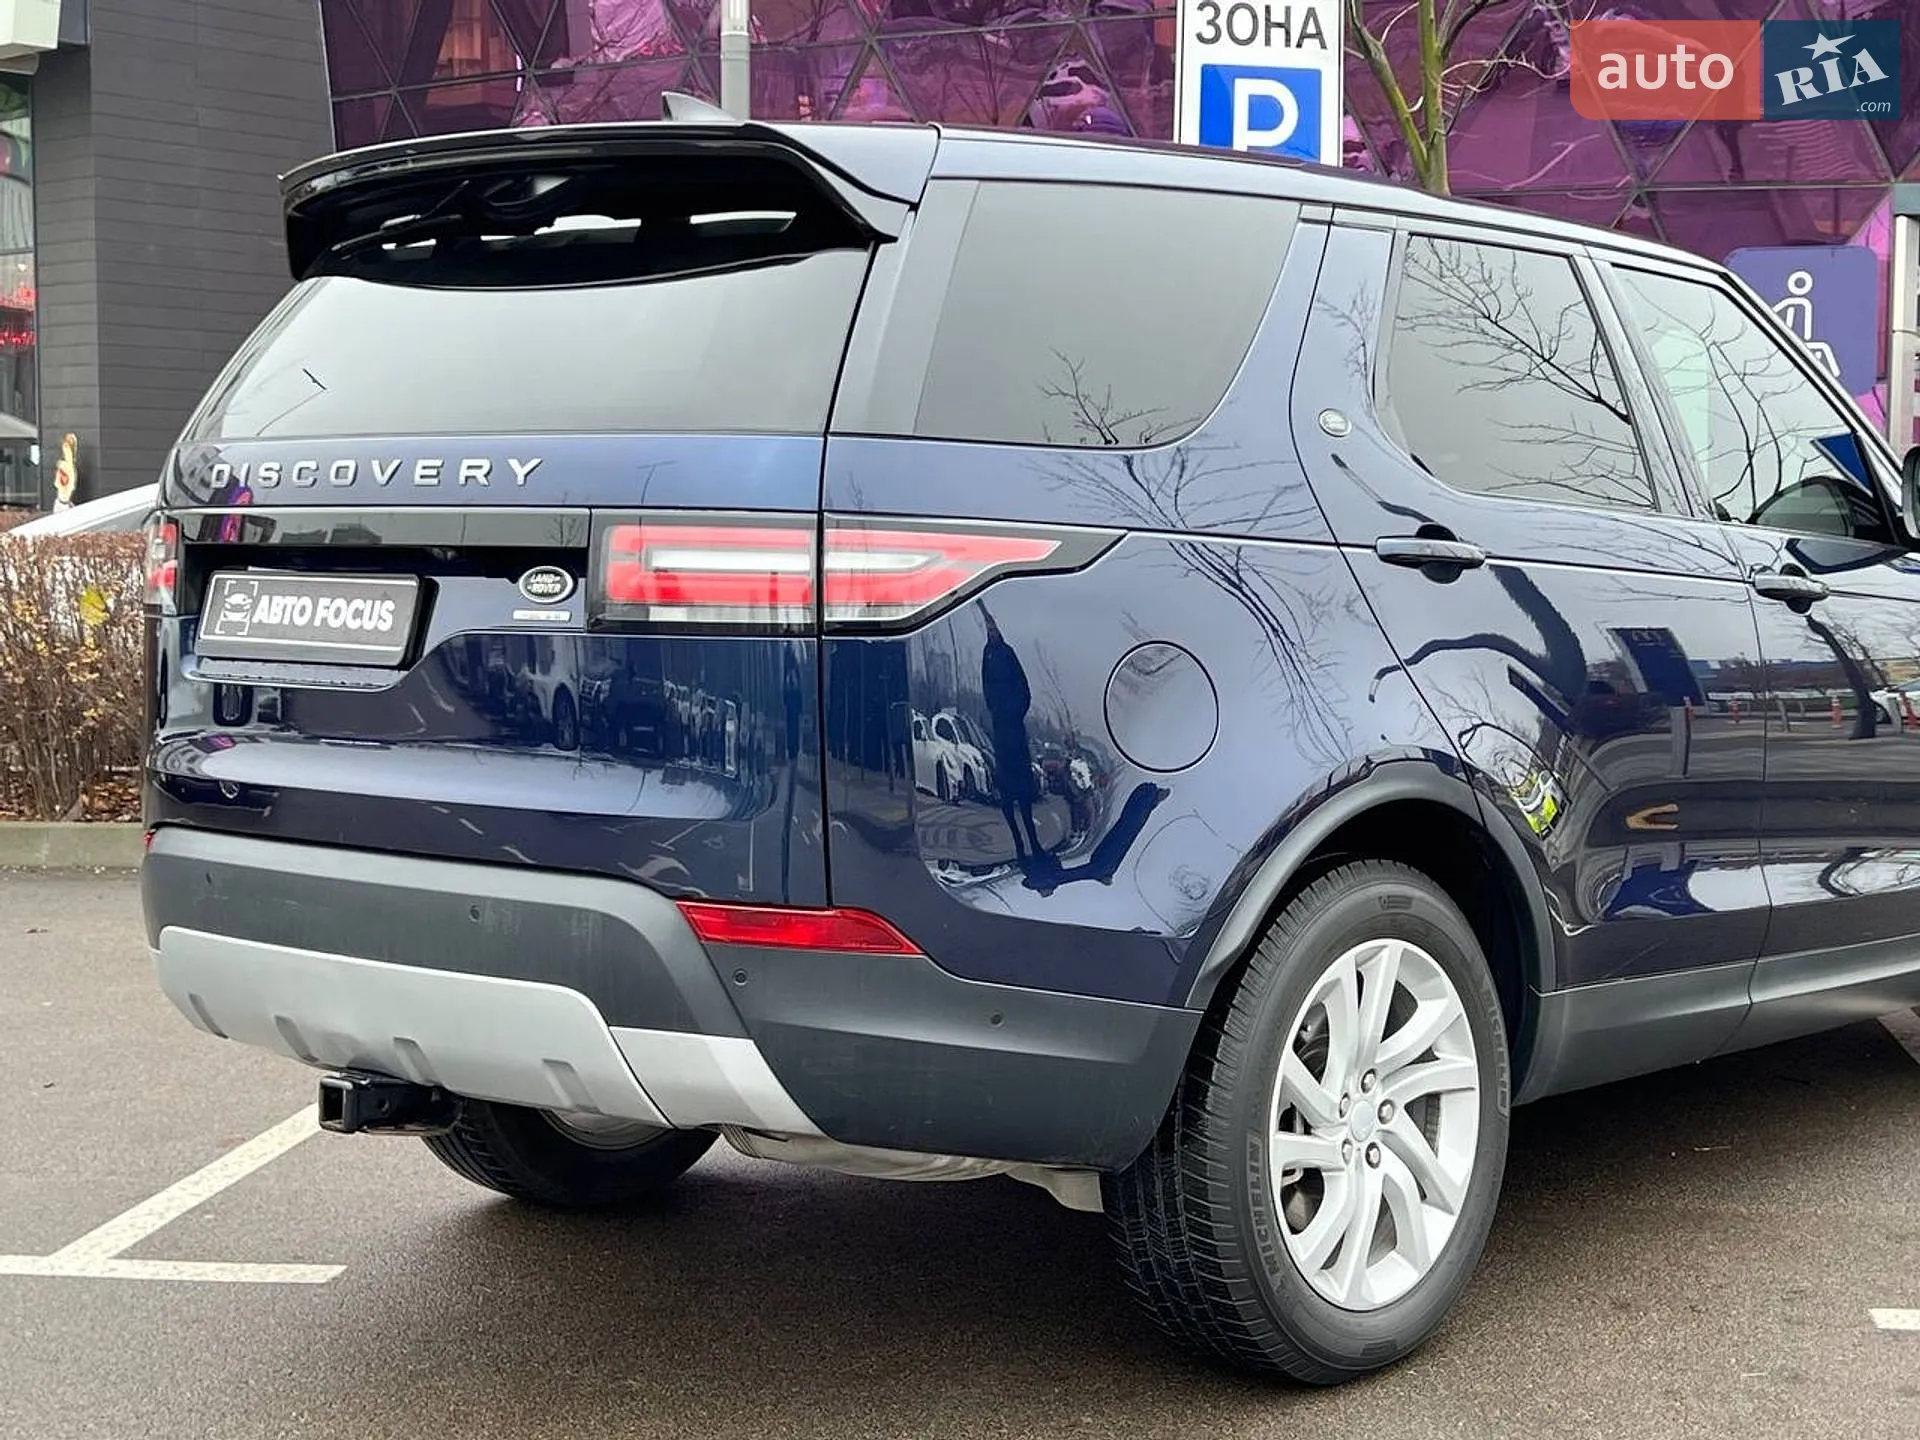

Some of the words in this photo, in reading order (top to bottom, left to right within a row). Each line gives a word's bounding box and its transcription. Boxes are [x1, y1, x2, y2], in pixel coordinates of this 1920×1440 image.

[1196, 1, 1327, 50] ЗОНА
[1233, 77, 1299, 152] P
[210, 457, 543, 489] DISCOVERY
[530, 573, 556, 583] LAND
[313, 597, 396, 632] FOCUS
